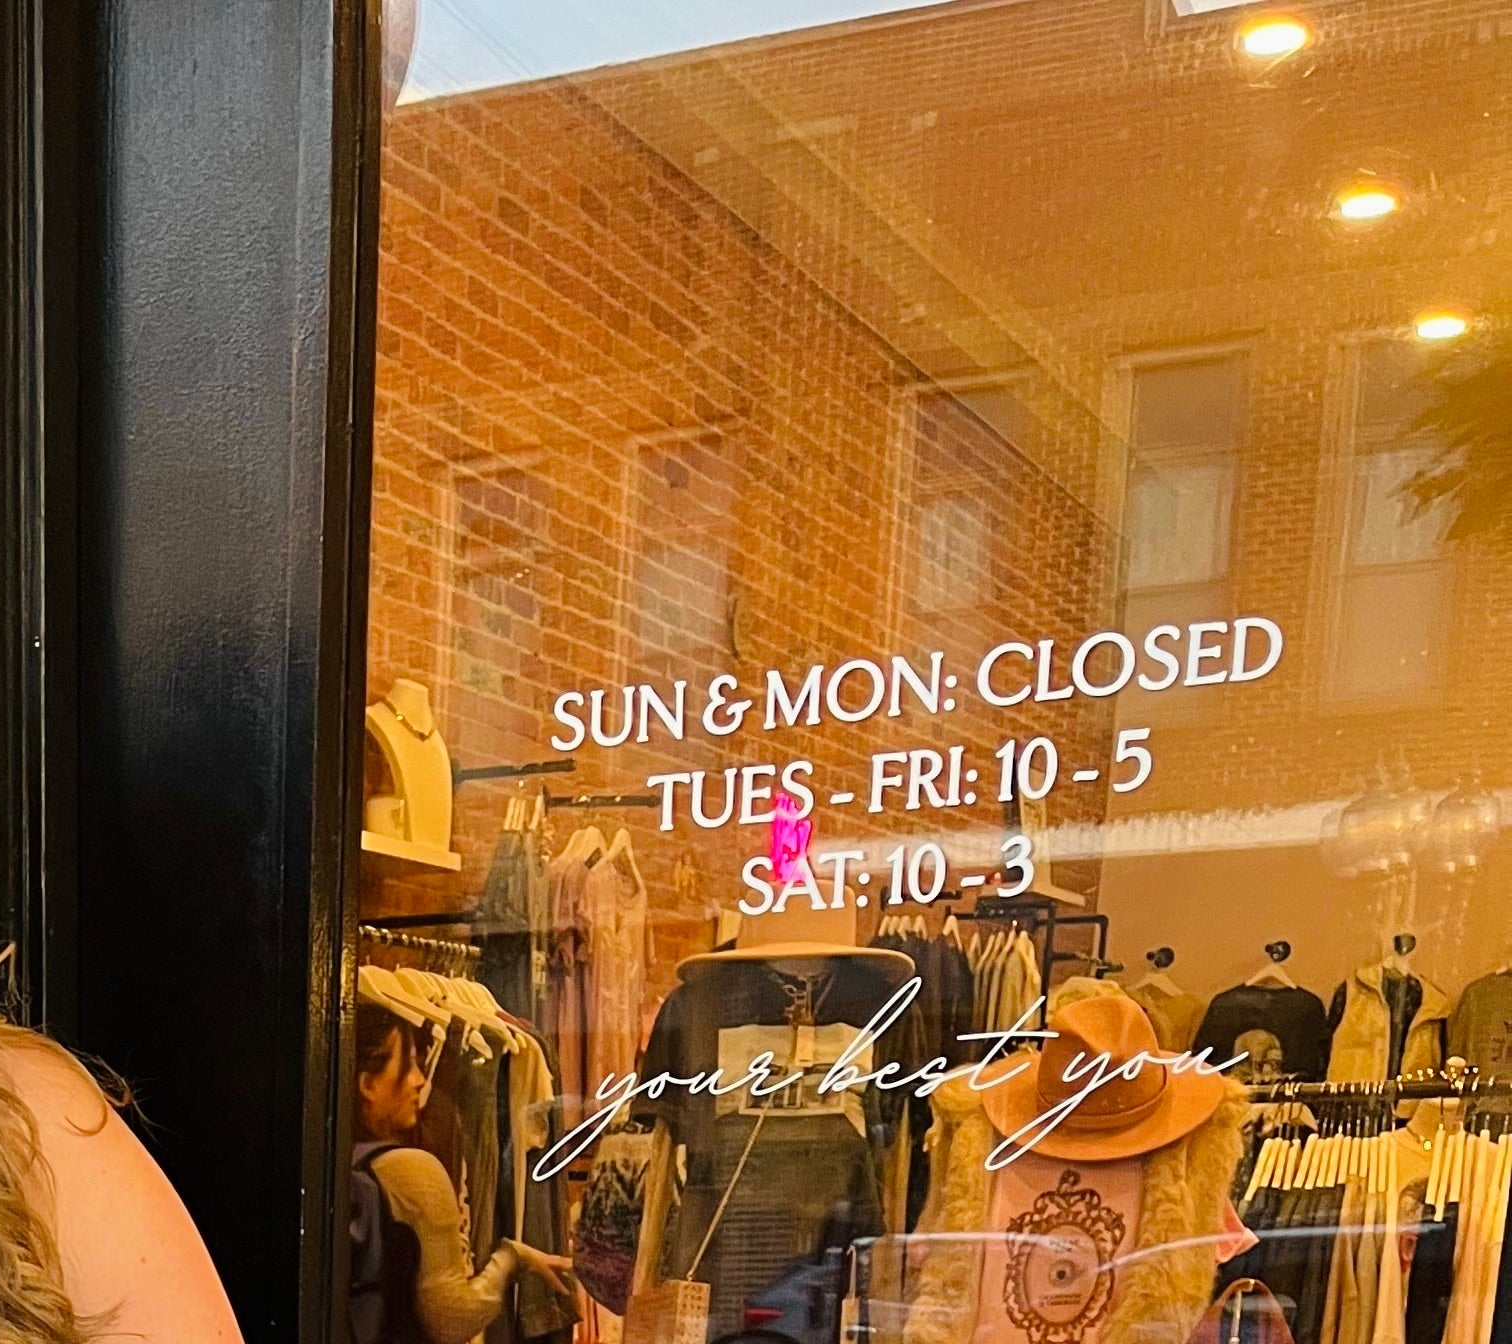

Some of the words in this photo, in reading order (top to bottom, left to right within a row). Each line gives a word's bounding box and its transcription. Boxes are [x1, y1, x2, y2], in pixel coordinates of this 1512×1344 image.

[551, 681, 687, 752] SUN
[702, 674, 752, 735] &
[763, 652, 957, 730] MON:
[977, 617, 1284, 706] CLOSED
[647, 760, 815, 832] TUES
[868, 746, 978, 813] FRI:
[996, 737, 1059, 802] 10
[1113, 728, 1153, 792] 5
[738, 850, 870, 916] SAT:
[886, 842, 947, 905] 10
[997, 835, 1035, 897] 3
[532, 1048, 803, 1182] your
[818, 976, 1058, 1099] best
[985, 1046, 1249, 1172] you
